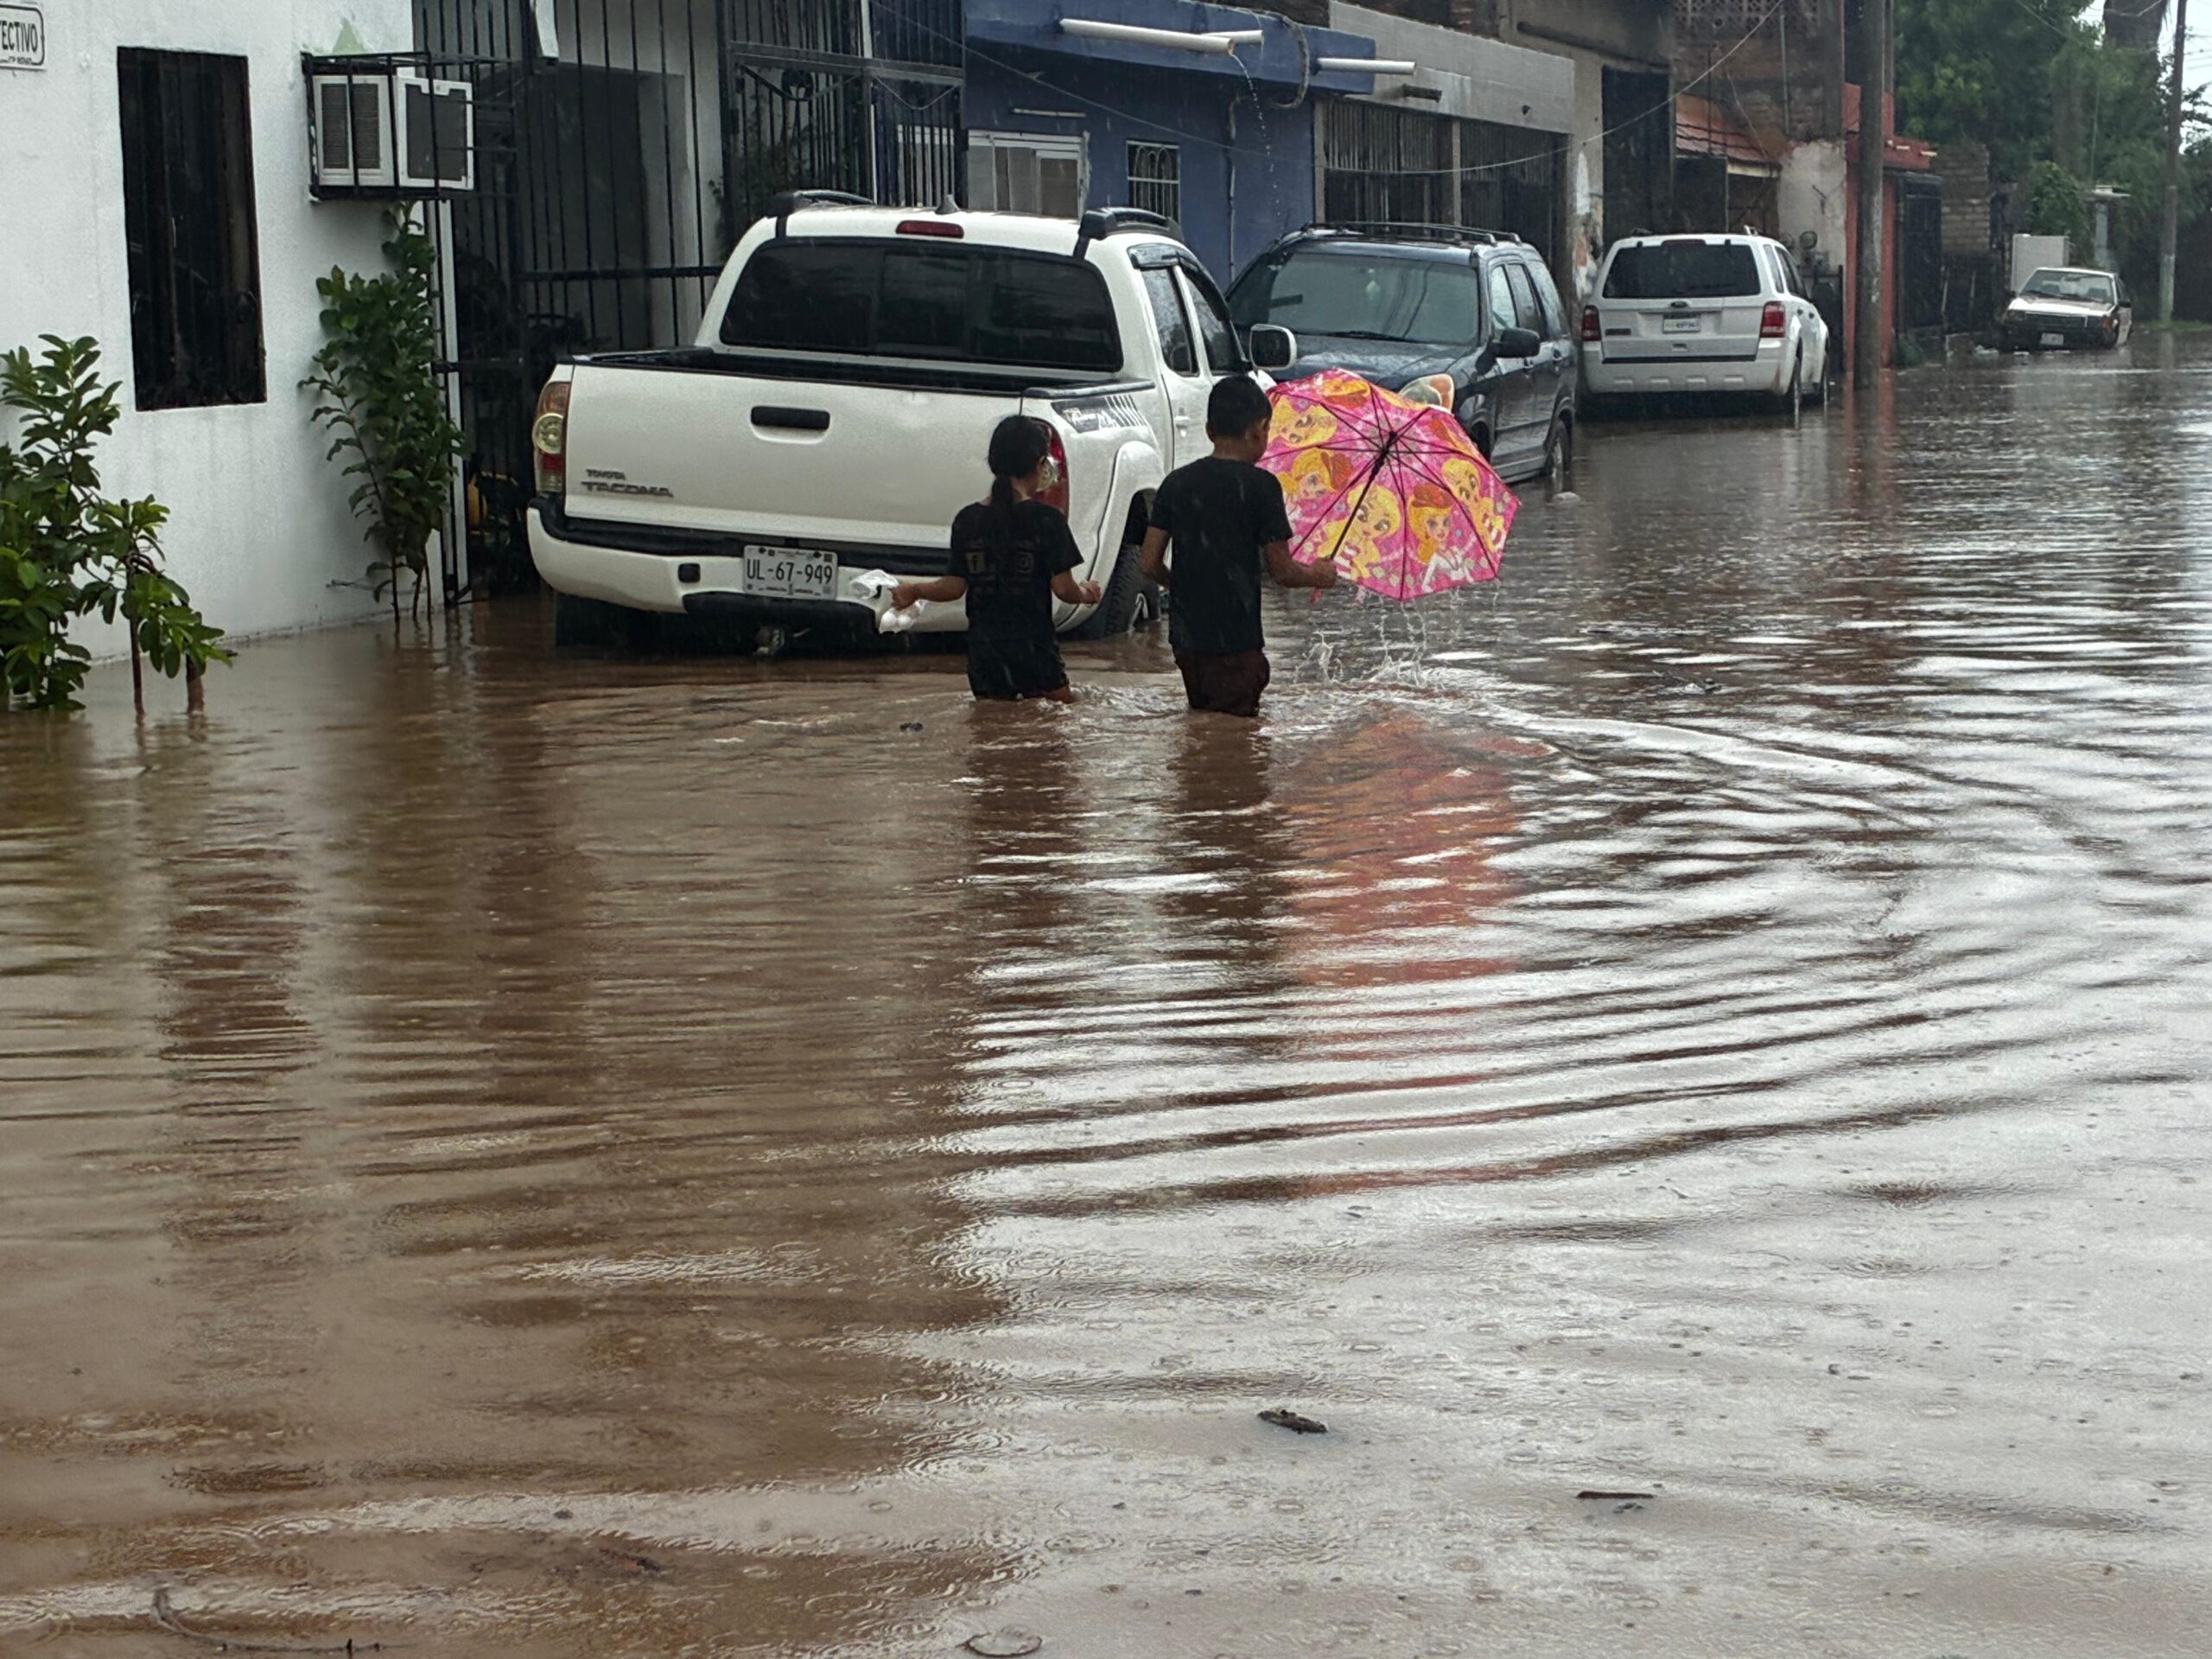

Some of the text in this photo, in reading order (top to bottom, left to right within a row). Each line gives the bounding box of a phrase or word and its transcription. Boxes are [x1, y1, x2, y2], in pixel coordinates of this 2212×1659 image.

[0, 20, 38, 53] ECTIVO
[586, 468, 626, 480] TOYOTA
[581, 481, 674, 498] TACOMA
[747, 558, 833, 584] UL-67-949
